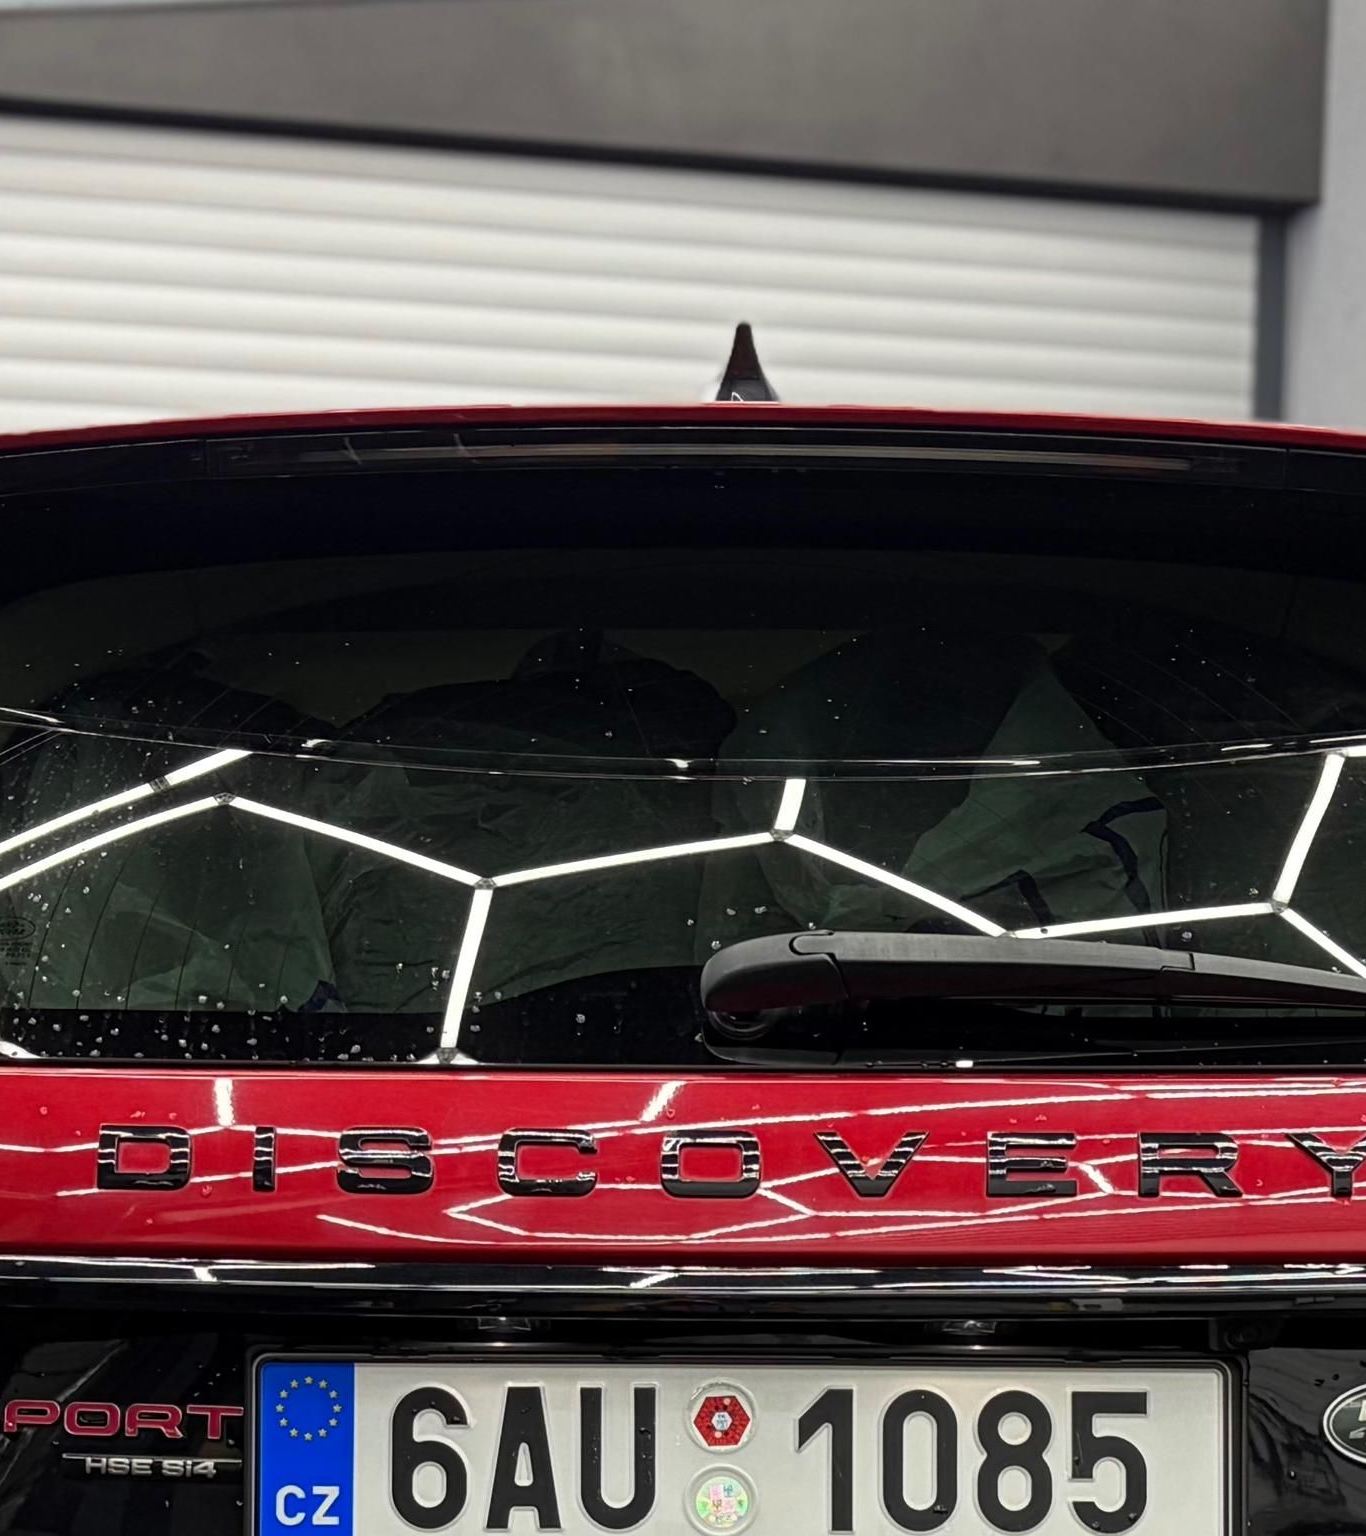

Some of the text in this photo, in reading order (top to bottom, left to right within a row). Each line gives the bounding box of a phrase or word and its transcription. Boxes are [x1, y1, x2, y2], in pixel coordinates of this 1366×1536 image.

[85, 1456, 217, 1479] HSE Si4
[389, 1384, 1149, 1536] 6AU 1085
[275, 1485, 340, 1527] CZ
